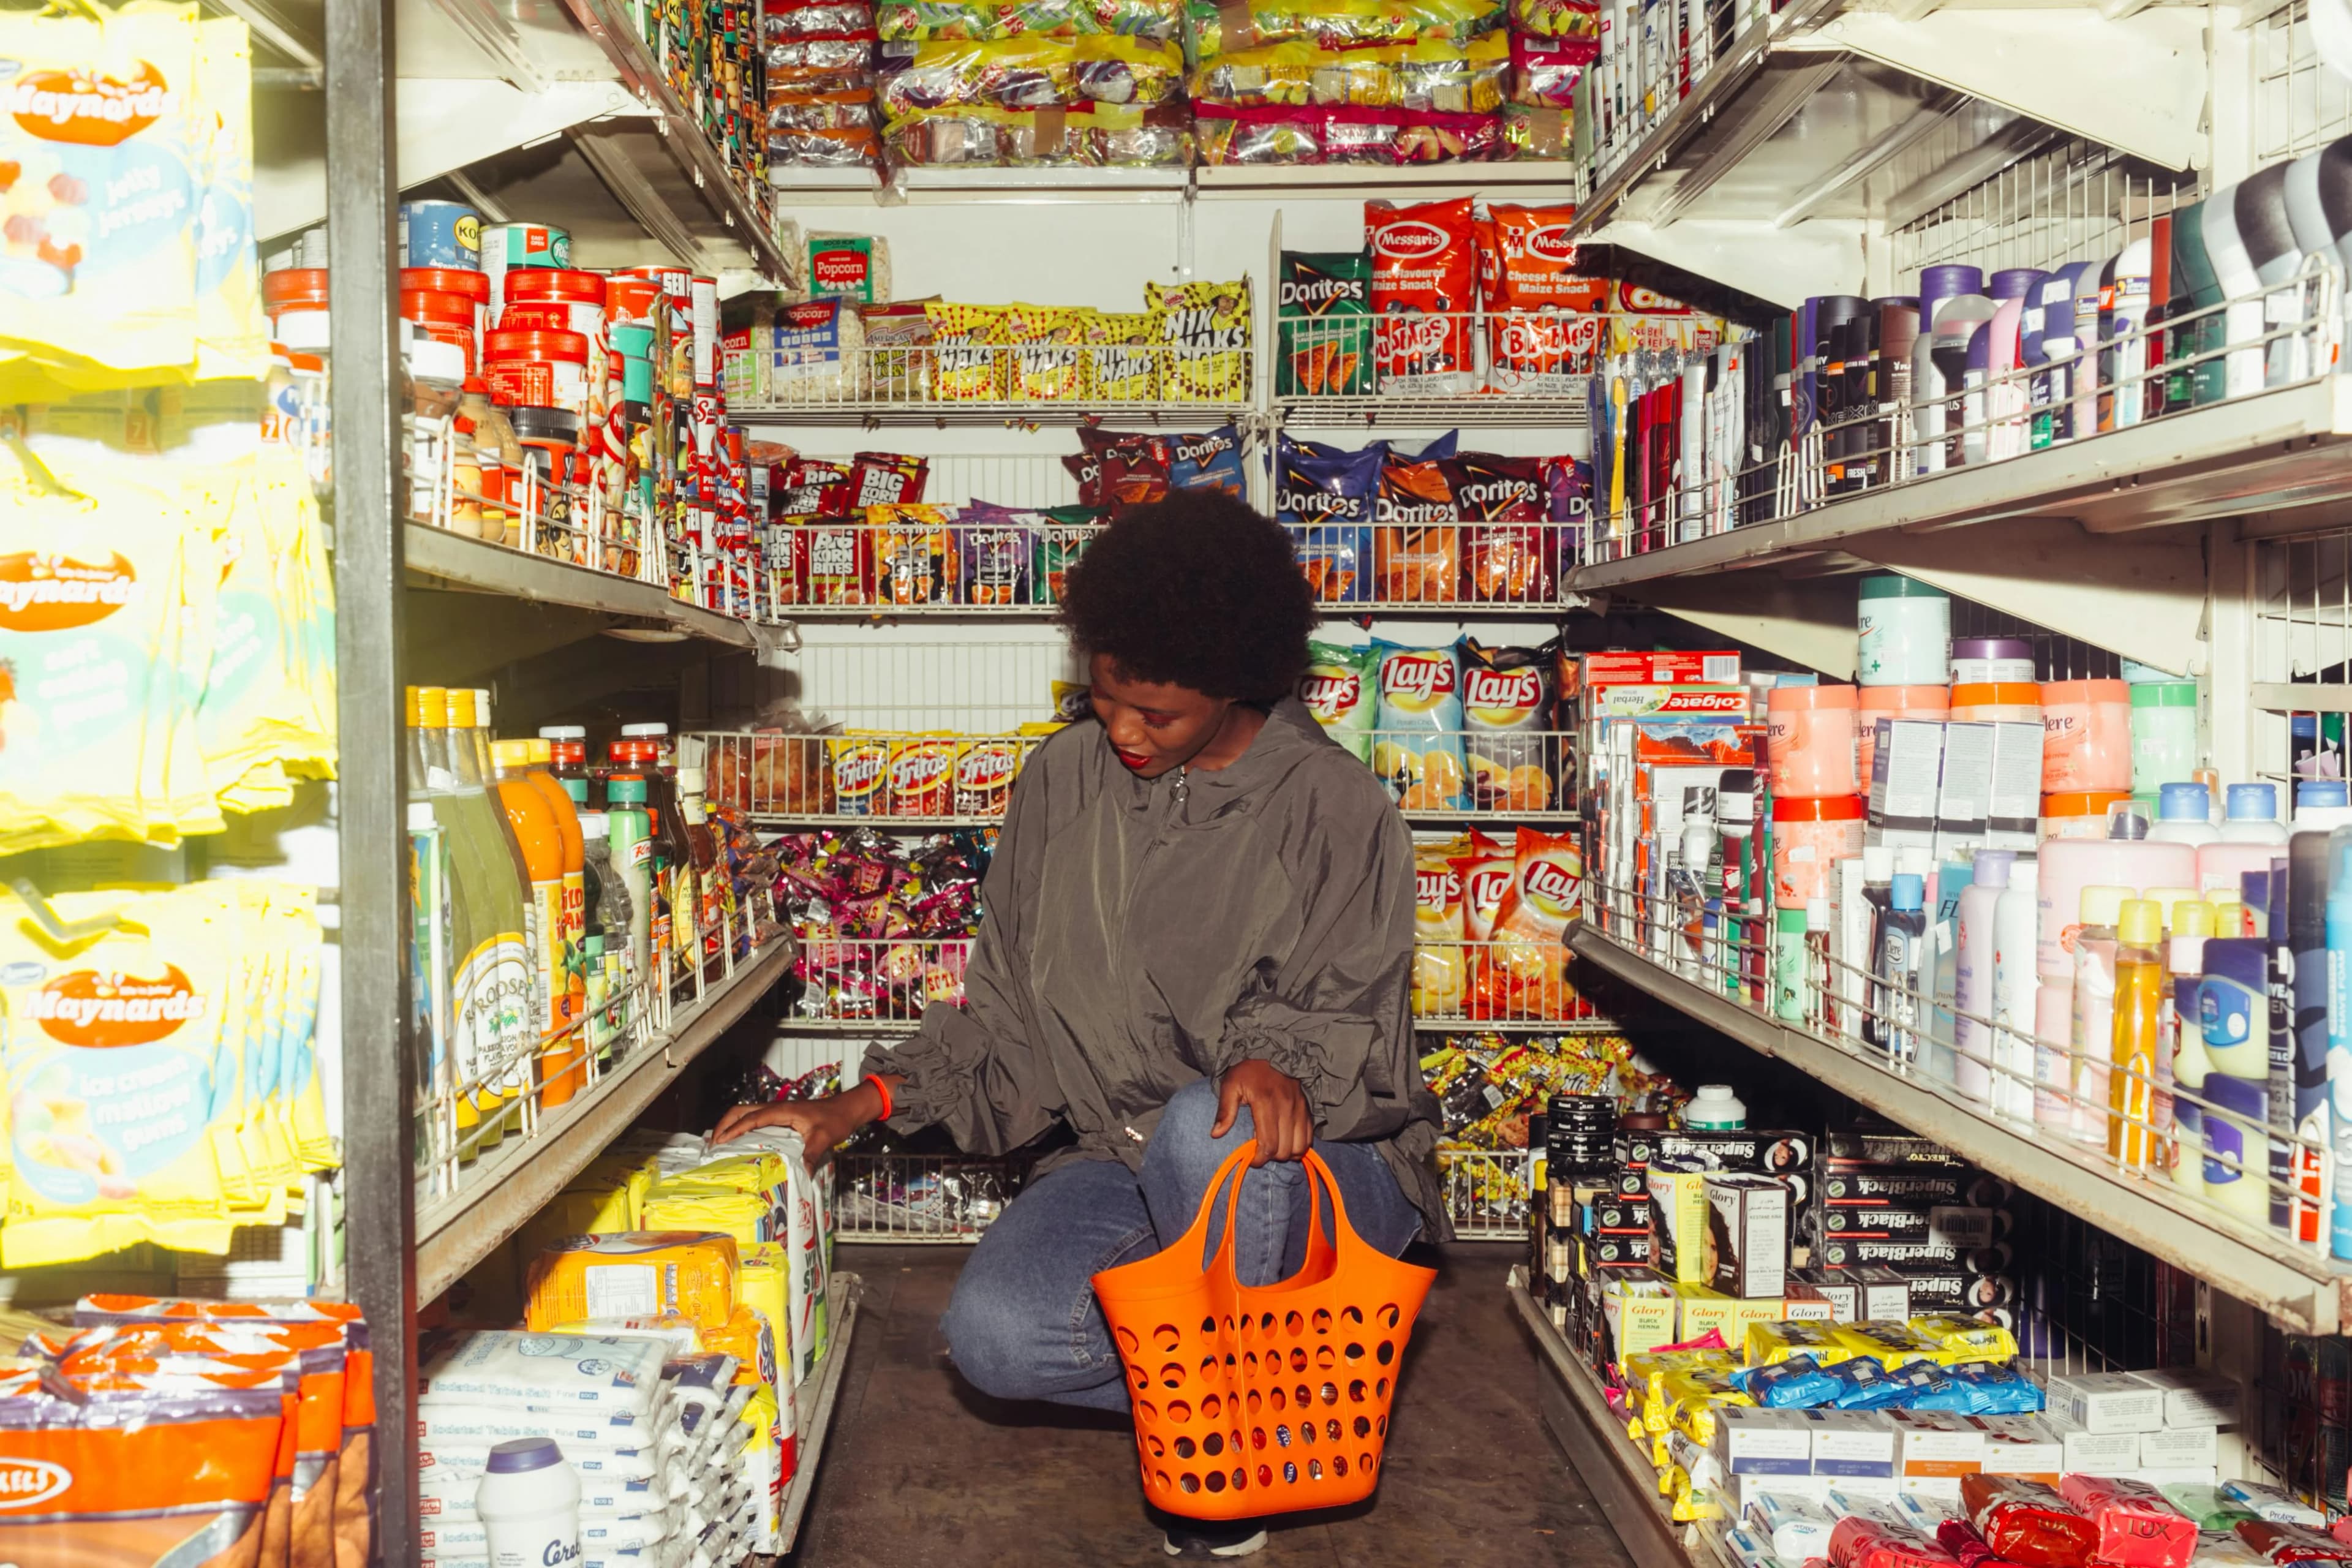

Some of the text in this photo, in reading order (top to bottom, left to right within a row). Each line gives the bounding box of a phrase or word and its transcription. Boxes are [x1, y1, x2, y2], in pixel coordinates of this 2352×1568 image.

[1381, 233, 1441, 246] Messaris
[817, 262, 864, 278] Popcorn
[1395, 268, 1446, 278] Flavoured
[1507, 271, 1547, 282] Cheese
[1280, 279, 1363, 306] Doritos
[1400, 280, 1433, 290] Snack
[1518, 282, 1590, 293] Maize Snack
[1165, 307, 1217, 341] NIK
[724, 336, 747, 349] corn
[1178, 325, 1246, 361] NAKS
[1021, 349, 1077, 375] NAKS
[1101, 355, 1153, 383] NAKS
[1177, 436, 1233, 461] Doritos
[862, 468, 905, 492] BIG
[858, 486, 901, 503] KORN
[1460, 480, 1538, 508] Doritos
[1277, 489, 1361, 518] Doritos
[1376, 498, 1457, 522] Doritos
[812, 549, 853, 563] KORN
[812, 562, 854, 575] BITES
[0, 578, 146, 612] aynards
[1382, 658, 1452, 702] Lay's
[1466, 670, 1536, 709] Lay's
[1613, 695, 1644, 704] Herbal
[1670, 695, 1746, 709] Colgate
[892, 753, 949, 790] Fritos
[960, 750, 1016, 783] Fritos
[22, 989, 206, 1028] Maynards
[1858, 1179, 1957, 1195] SuperBlack
[1709, 1188, 1736, 1208] Glory
[1858, 1246, 1956, 1261] SuperBlack
[1826, 1291, 1852, 1303] lory
[1631, 1305, 1667, 1317] Glory
[1692, 1307, 1728, 1319] Glory
[1740, 1308, 1777, 1320] Glory
[1790, 1308, 1826, 1319] Glory
[2269, 1510, 2296, 1522] Protex
[2128, 1518, 2171, 1542] LUX
